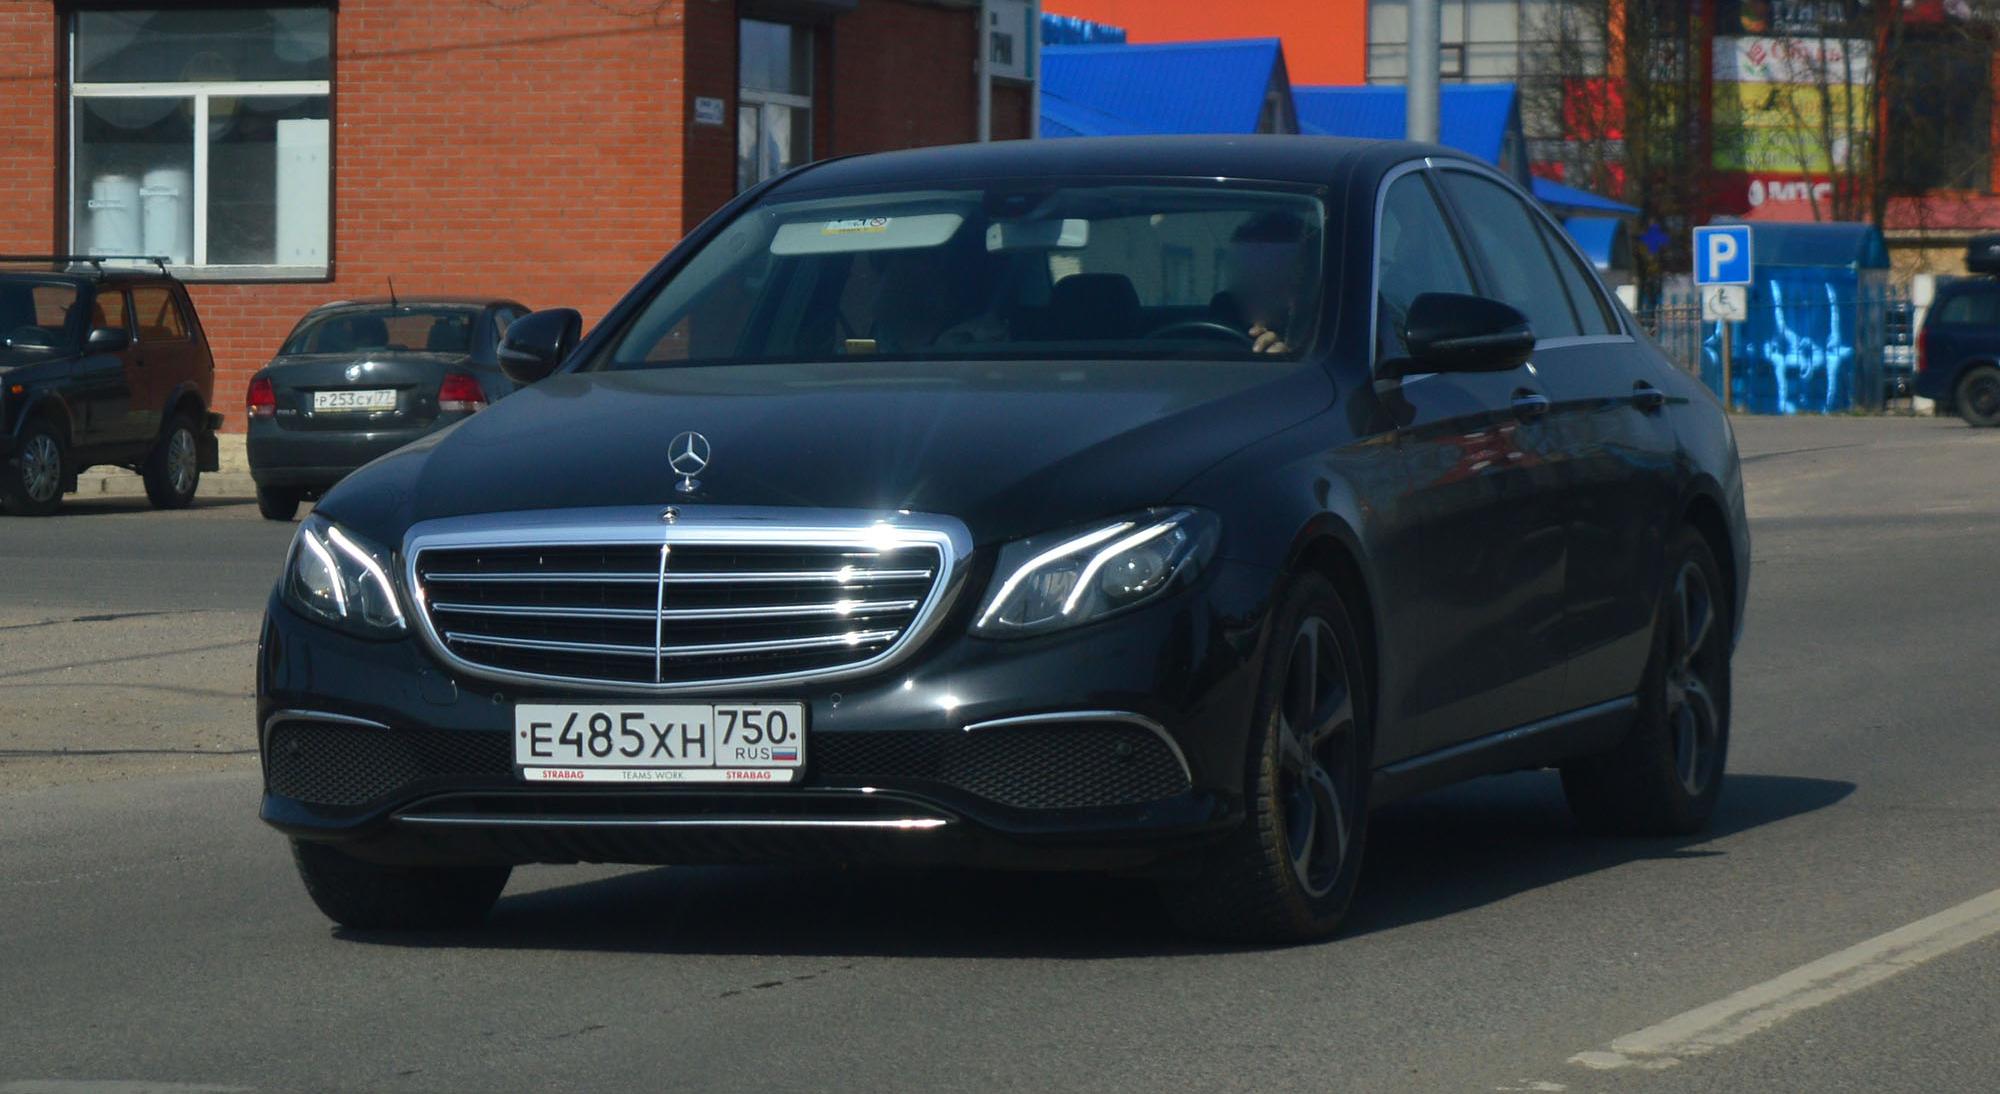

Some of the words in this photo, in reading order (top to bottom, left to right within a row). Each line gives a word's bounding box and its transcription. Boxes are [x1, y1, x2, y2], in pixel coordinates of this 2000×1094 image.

[1708, 233, 1737, 280] P
[718, 710, 788, 745] 750
[735, 747, 770, 760] RUS
[542, 769, 584, 779] STRABAG
[622, 770, 652, 780] TEAMS
[725, 770, 772, 780] STRABAG
